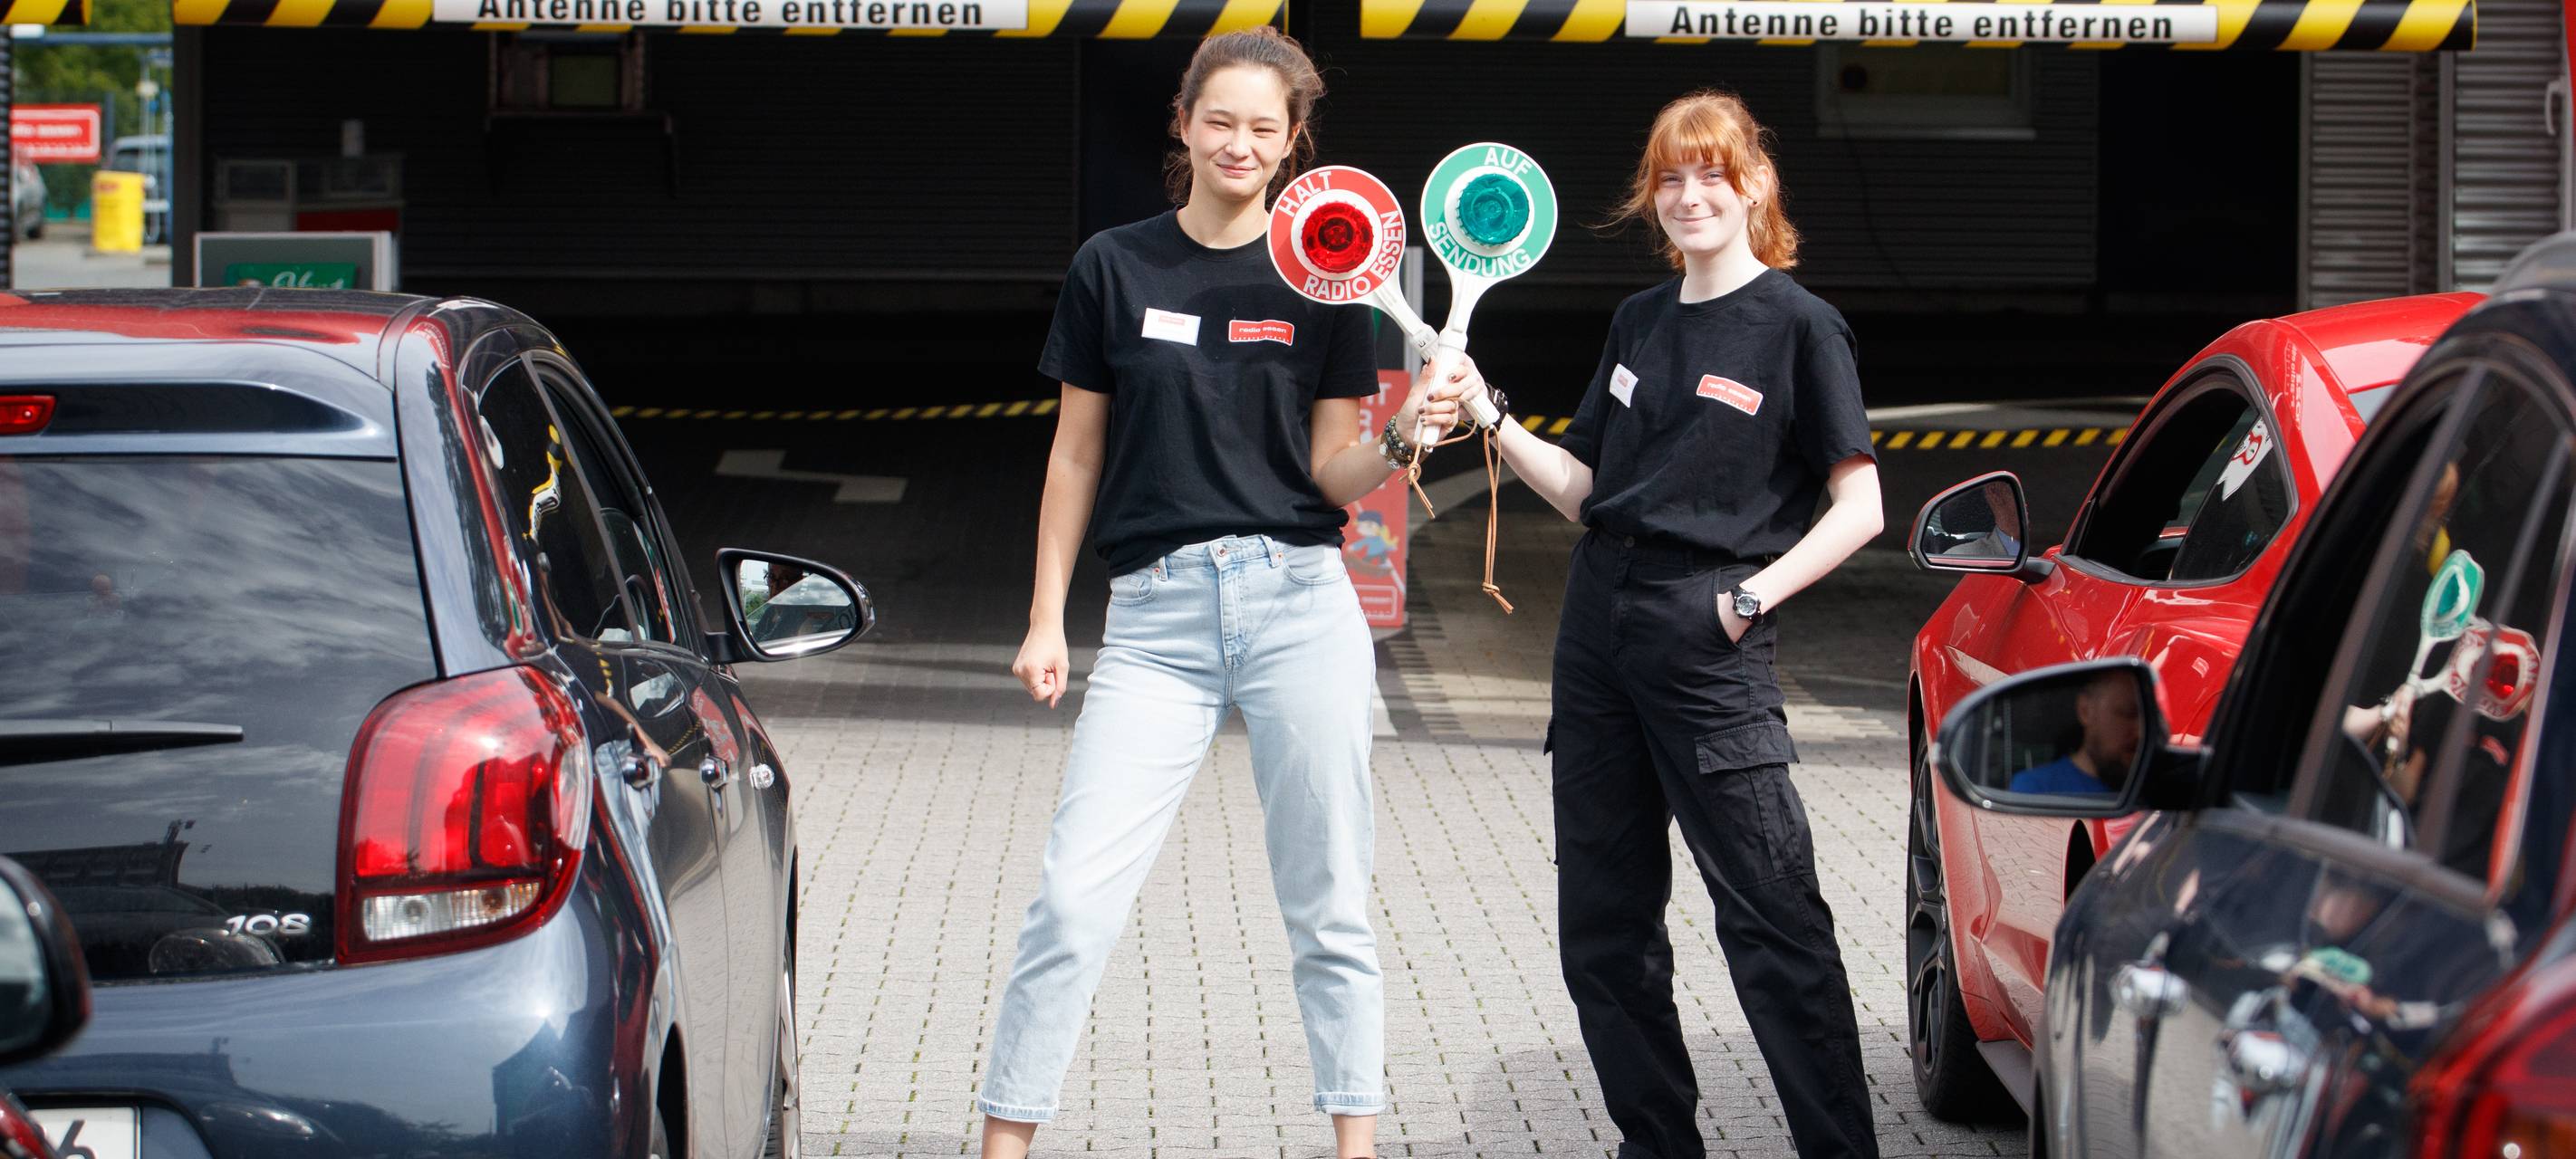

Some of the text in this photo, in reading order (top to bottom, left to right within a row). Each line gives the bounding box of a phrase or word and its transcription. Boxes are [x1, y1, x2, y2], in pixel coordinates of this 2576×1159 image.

[477, 0, 982, 25] Antenne bitte entfernen
[1669, 7, 2172, 39] Antenne bitte entfernen
[1484, 146, 1533, 176] AUF
[1277, 170, 1332, 218] HALT
[1303, 211, 1403, 301] RADIO ESSEN
[1428, 221, 1532, 277] SENDUNG
[226, 913, 311, 936] 108
